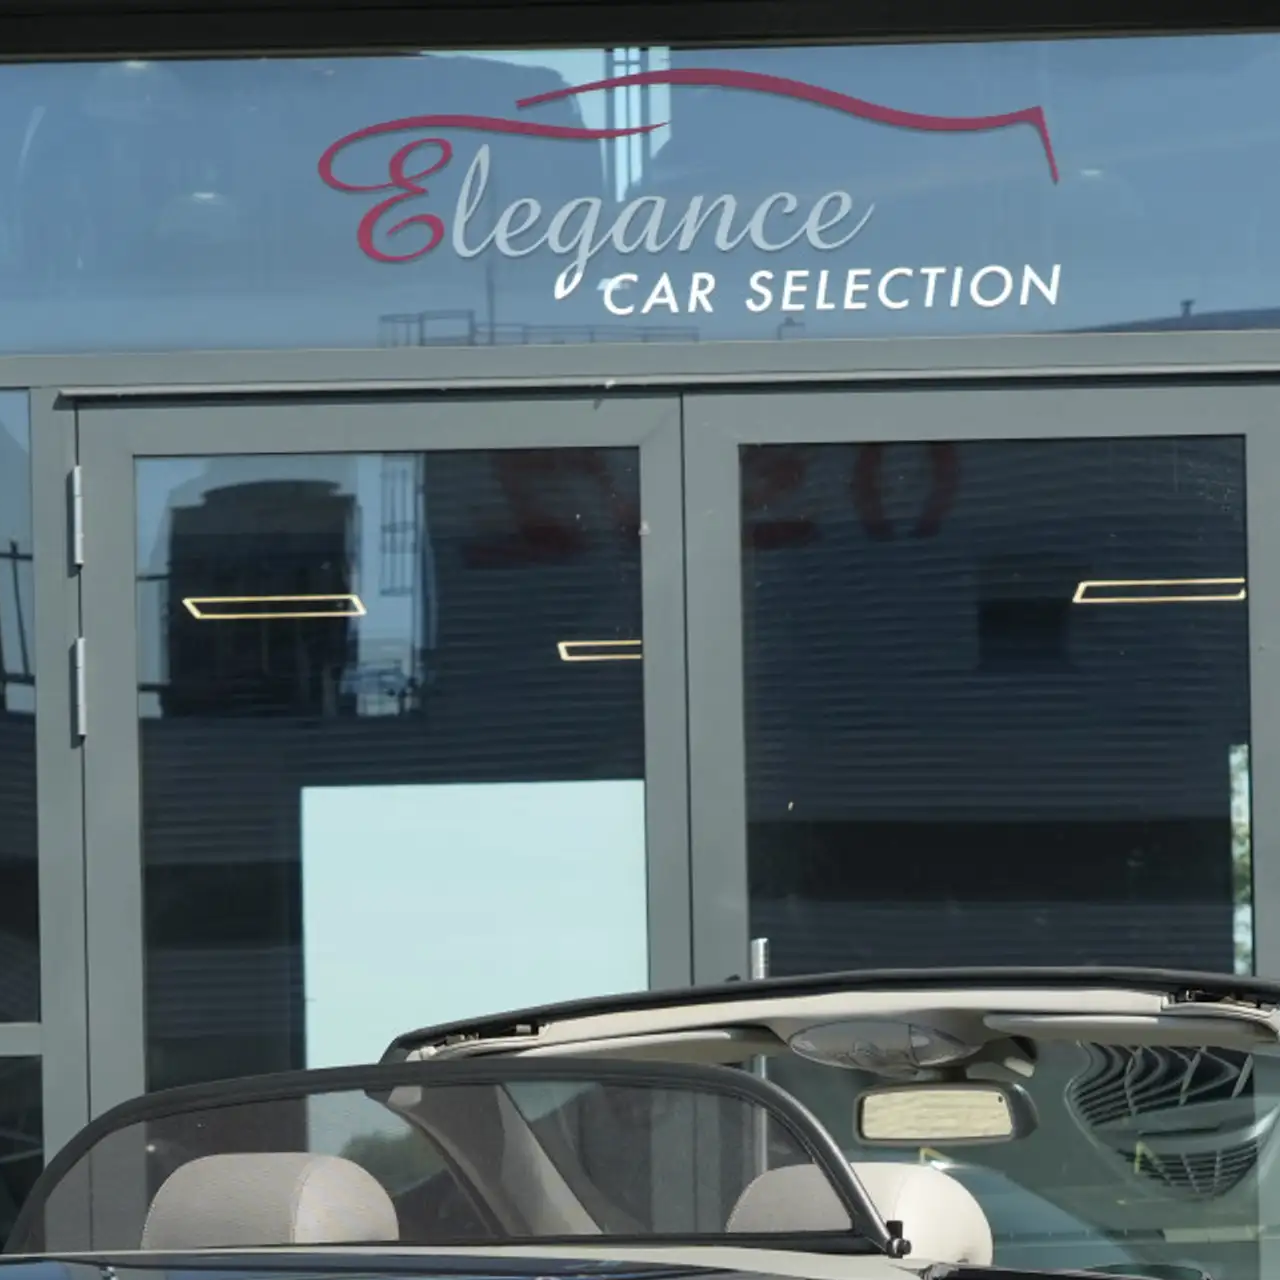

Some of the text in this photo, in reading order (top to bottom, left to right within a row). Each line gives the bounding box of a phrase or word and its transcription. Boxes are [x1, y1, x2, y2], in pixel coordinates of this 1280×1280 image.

[318, 128, 876, 300] Elegance
[601, 263, 1063, 317] CAR SELECTION
